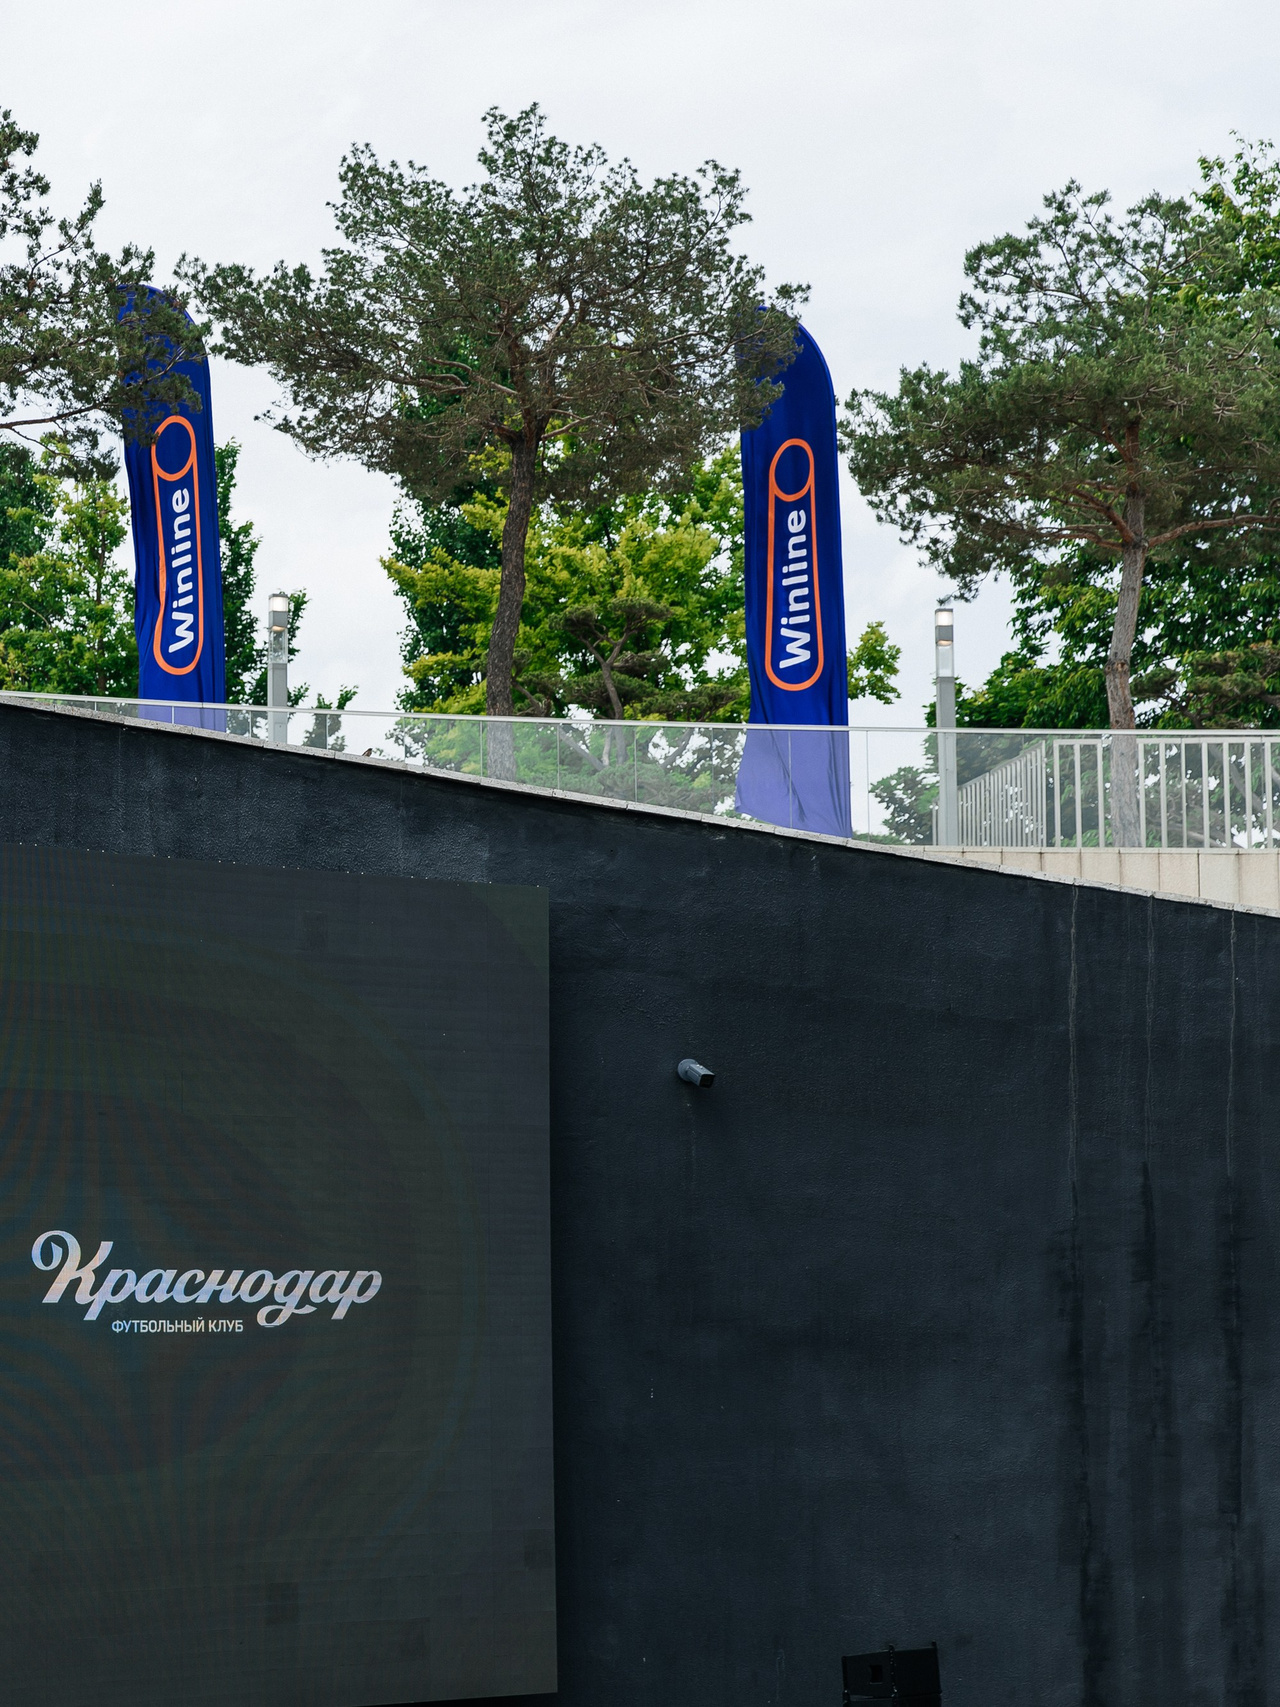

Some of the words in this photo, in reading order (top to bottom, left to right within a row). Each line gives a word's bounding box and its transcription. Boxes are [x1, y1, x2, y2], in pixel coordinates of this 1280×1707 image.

[168, 487, 195, 654] Winline
[779, 509, 811, 669] Winline
[31, 1229, 383, 1327] Краснодар
[111, 1318, 205, 1334] ФУТБОЛЬНЫЙ
[208, 1318, 244, 1334] КЛУБ
